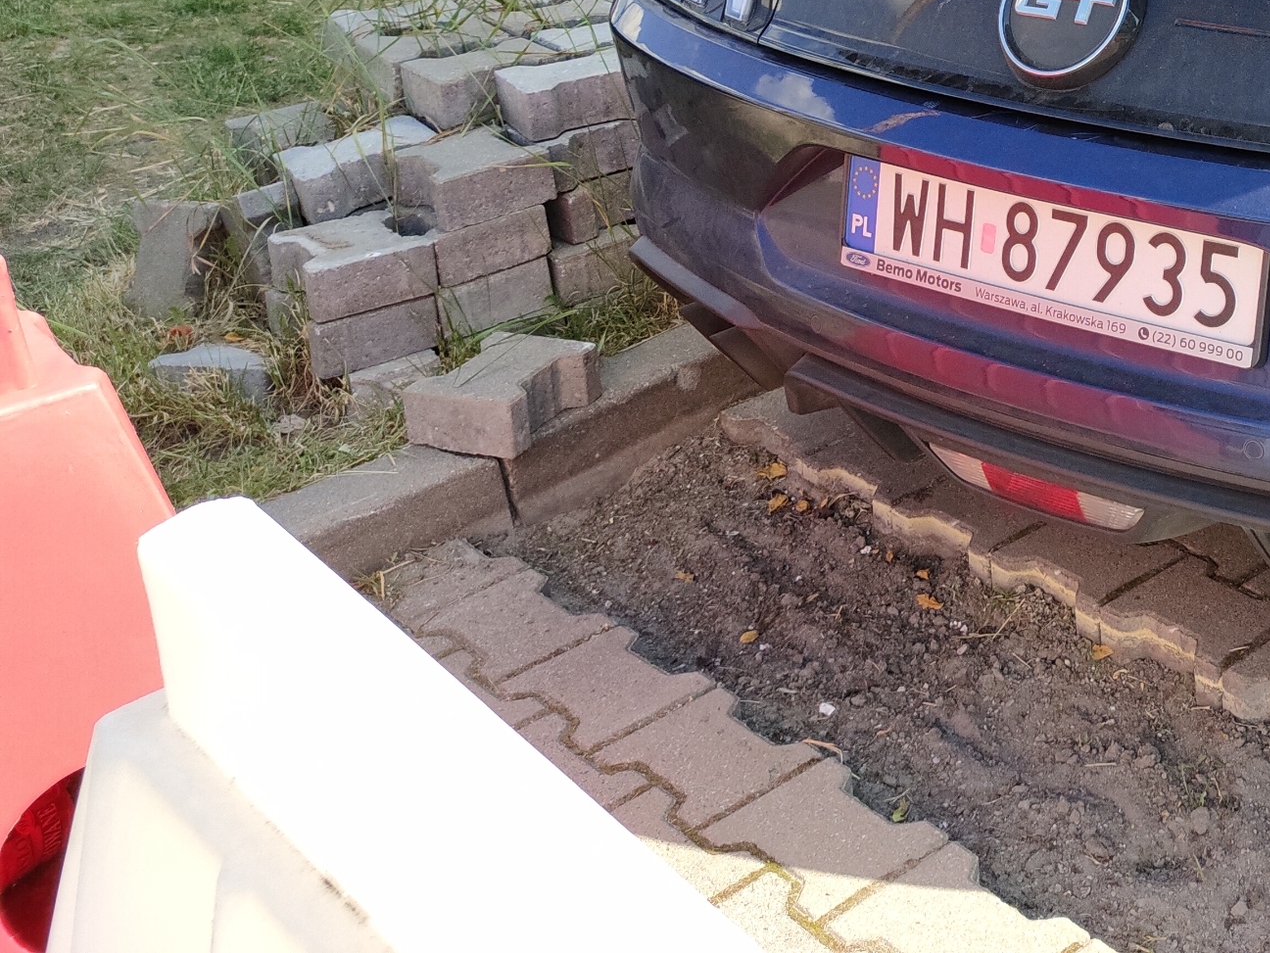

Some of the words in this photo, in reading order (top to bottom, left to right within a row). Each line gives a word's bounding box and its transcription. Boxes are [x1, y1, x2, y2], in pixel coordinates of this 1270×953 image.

[851, 213, 872, 238] PL
[892, 173, 975, 269] WH
[1001, 201, 1239, 329] 87935
[876, 259, 913, 279] Bemo
[915, 270, 962, 292] Motors
[975, 287, 1029, 312] Warszawa,
[1030, 302, 1043, 315] al.
[1045, 305, 1104, 329] Krakowska
[1106, 319, 1127, 334] 169
[1152, 330, 1176, 347] (22)
[1180, 338, 1196, 350] 60
[1199, 341, 1223, 356] 999
[1226, 348, 1243, 361] 00
